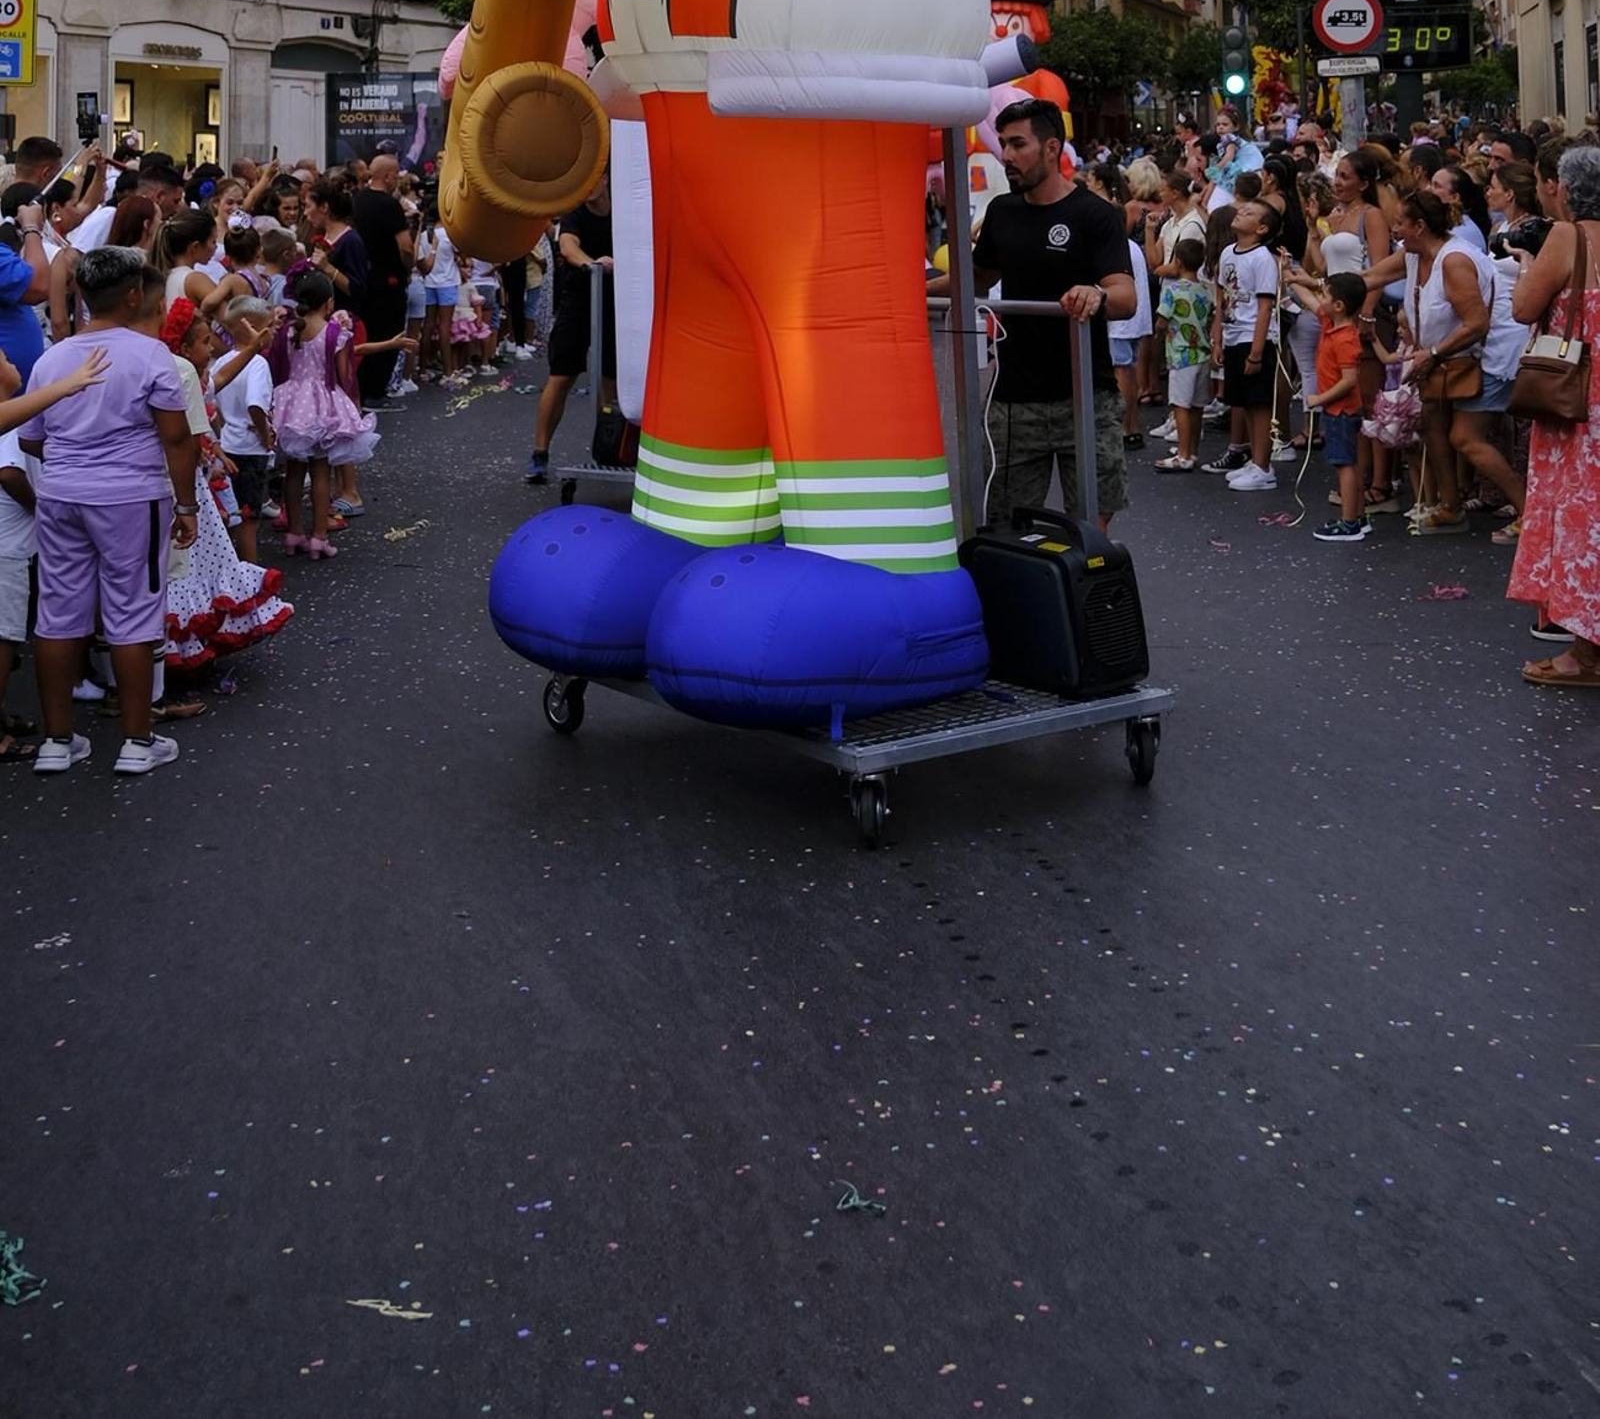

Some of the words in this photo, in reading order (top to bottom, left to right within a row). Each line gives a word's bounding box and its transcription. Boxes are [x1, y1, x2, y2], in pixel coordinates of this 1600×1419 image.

[0, 2, 15, 16] 0
[340, 87, 351, 97] NO
[352, 87, 362, 97] ES
[363, 84, 398, 97] VERANO
[340, 101, 349, 110] EN
[351, 96, 390, 111] ALMERÍA
[339, 112, 403, 123] COOLTURAL
